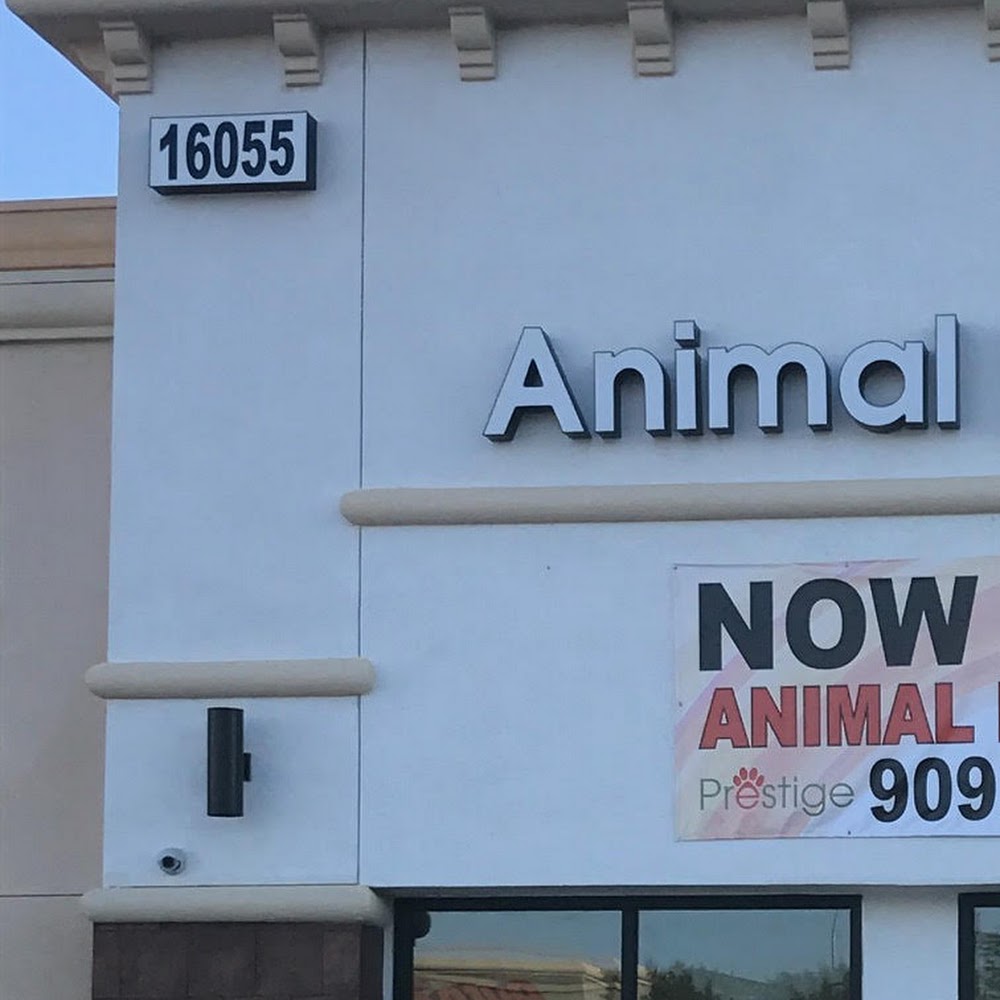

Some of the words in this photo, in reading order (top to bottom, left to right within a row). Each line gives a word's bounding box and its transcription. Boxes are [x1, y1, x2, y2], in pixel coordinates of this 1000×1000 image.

[160, 119, 294, 181] 16055
[483, 313, 960, 442] Animal
[698, 575, 978, 671] NOW
[698, 682, 975, 750] ANIMAL
[700, 771, 855, 816] Prestige
